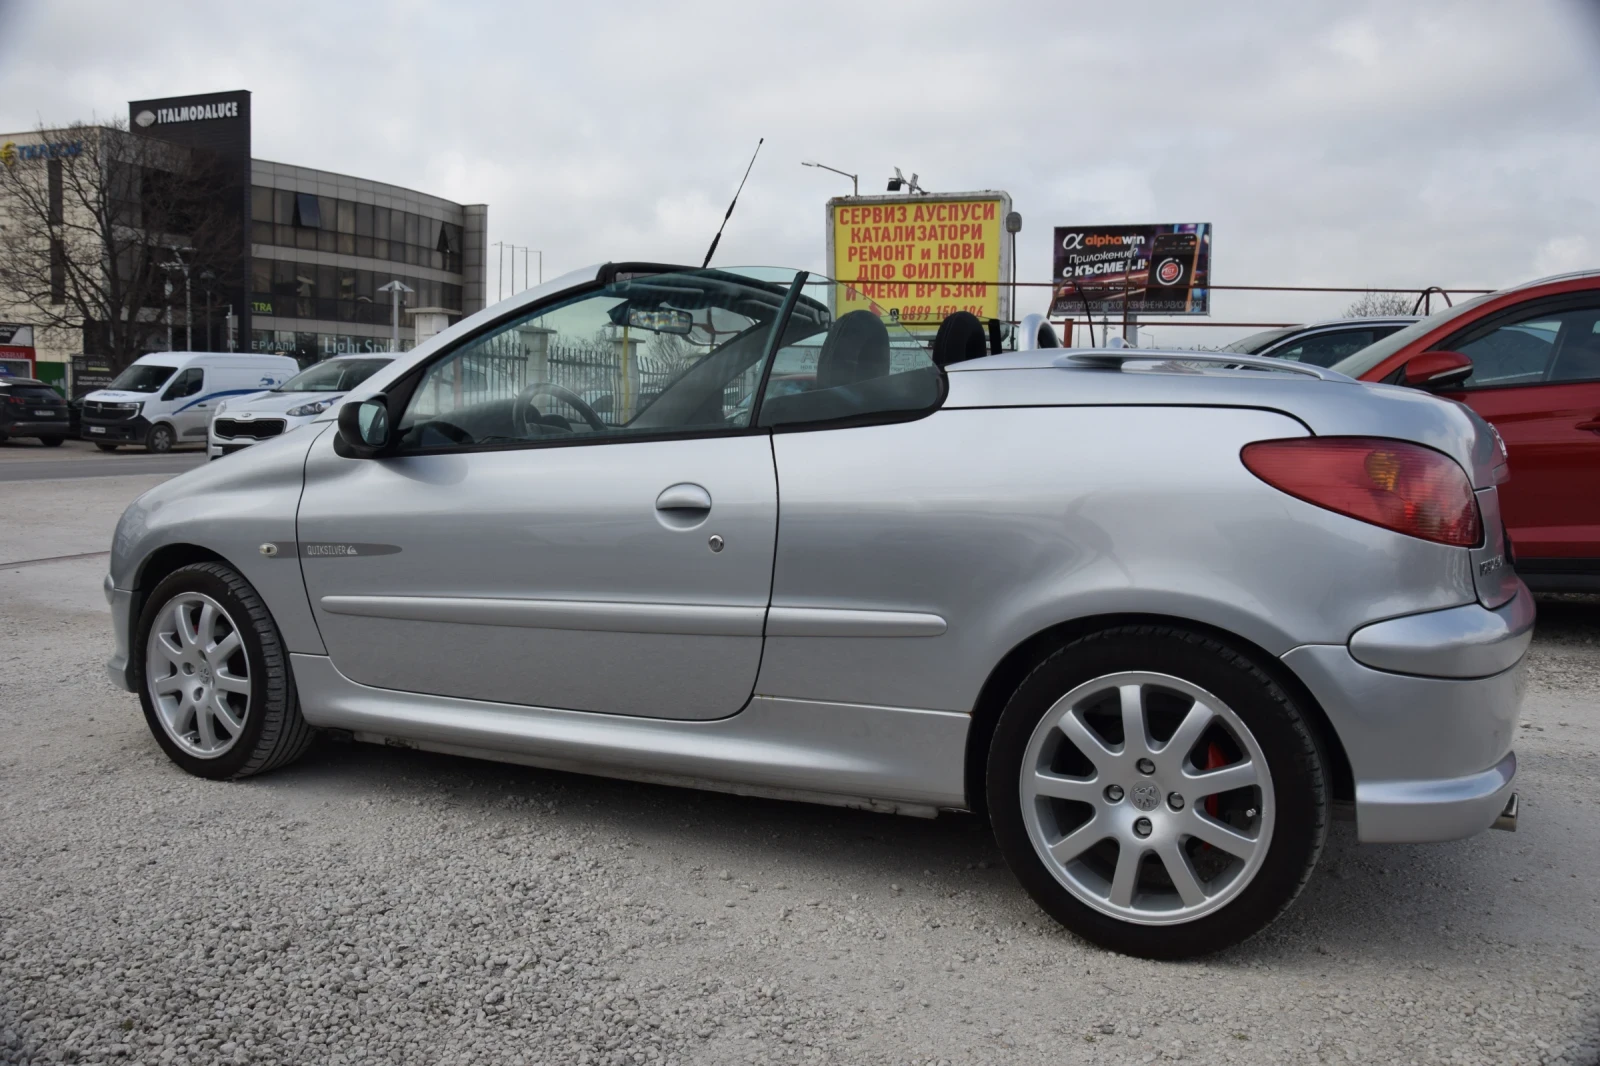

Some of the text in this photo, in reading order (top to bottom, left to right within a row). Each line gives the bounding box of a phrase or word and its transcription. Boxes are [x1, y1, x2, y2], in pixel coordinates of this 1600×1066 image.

[158, 102, 238, 124] ITALMODALUCE
[840, 203, 995, 225] СЕРВИЗ АУСПУСИ
[851, 224, 982, 244] КАТАЛИЗАТОРИ
[1085, 234, 1146, 248] alphawin
[848, 243, 985, 262] РЕМОНТ и НОВИ
[857, 262, 974, 281] ДПФ ФИЛТРИ
[846, 281, 986, 301] И МЕКИ ВРЪЗКИ
[252, 302, 272, 312] TRA
[902, 305, 931, 321] 0899
[936, 305, 957, 320] 150
[1126, 300, 1155, 308] АЗВИВАНЕ
[324, 336, 360, 354] Light
[307, 545, 346, 555] QUIKSILVER
